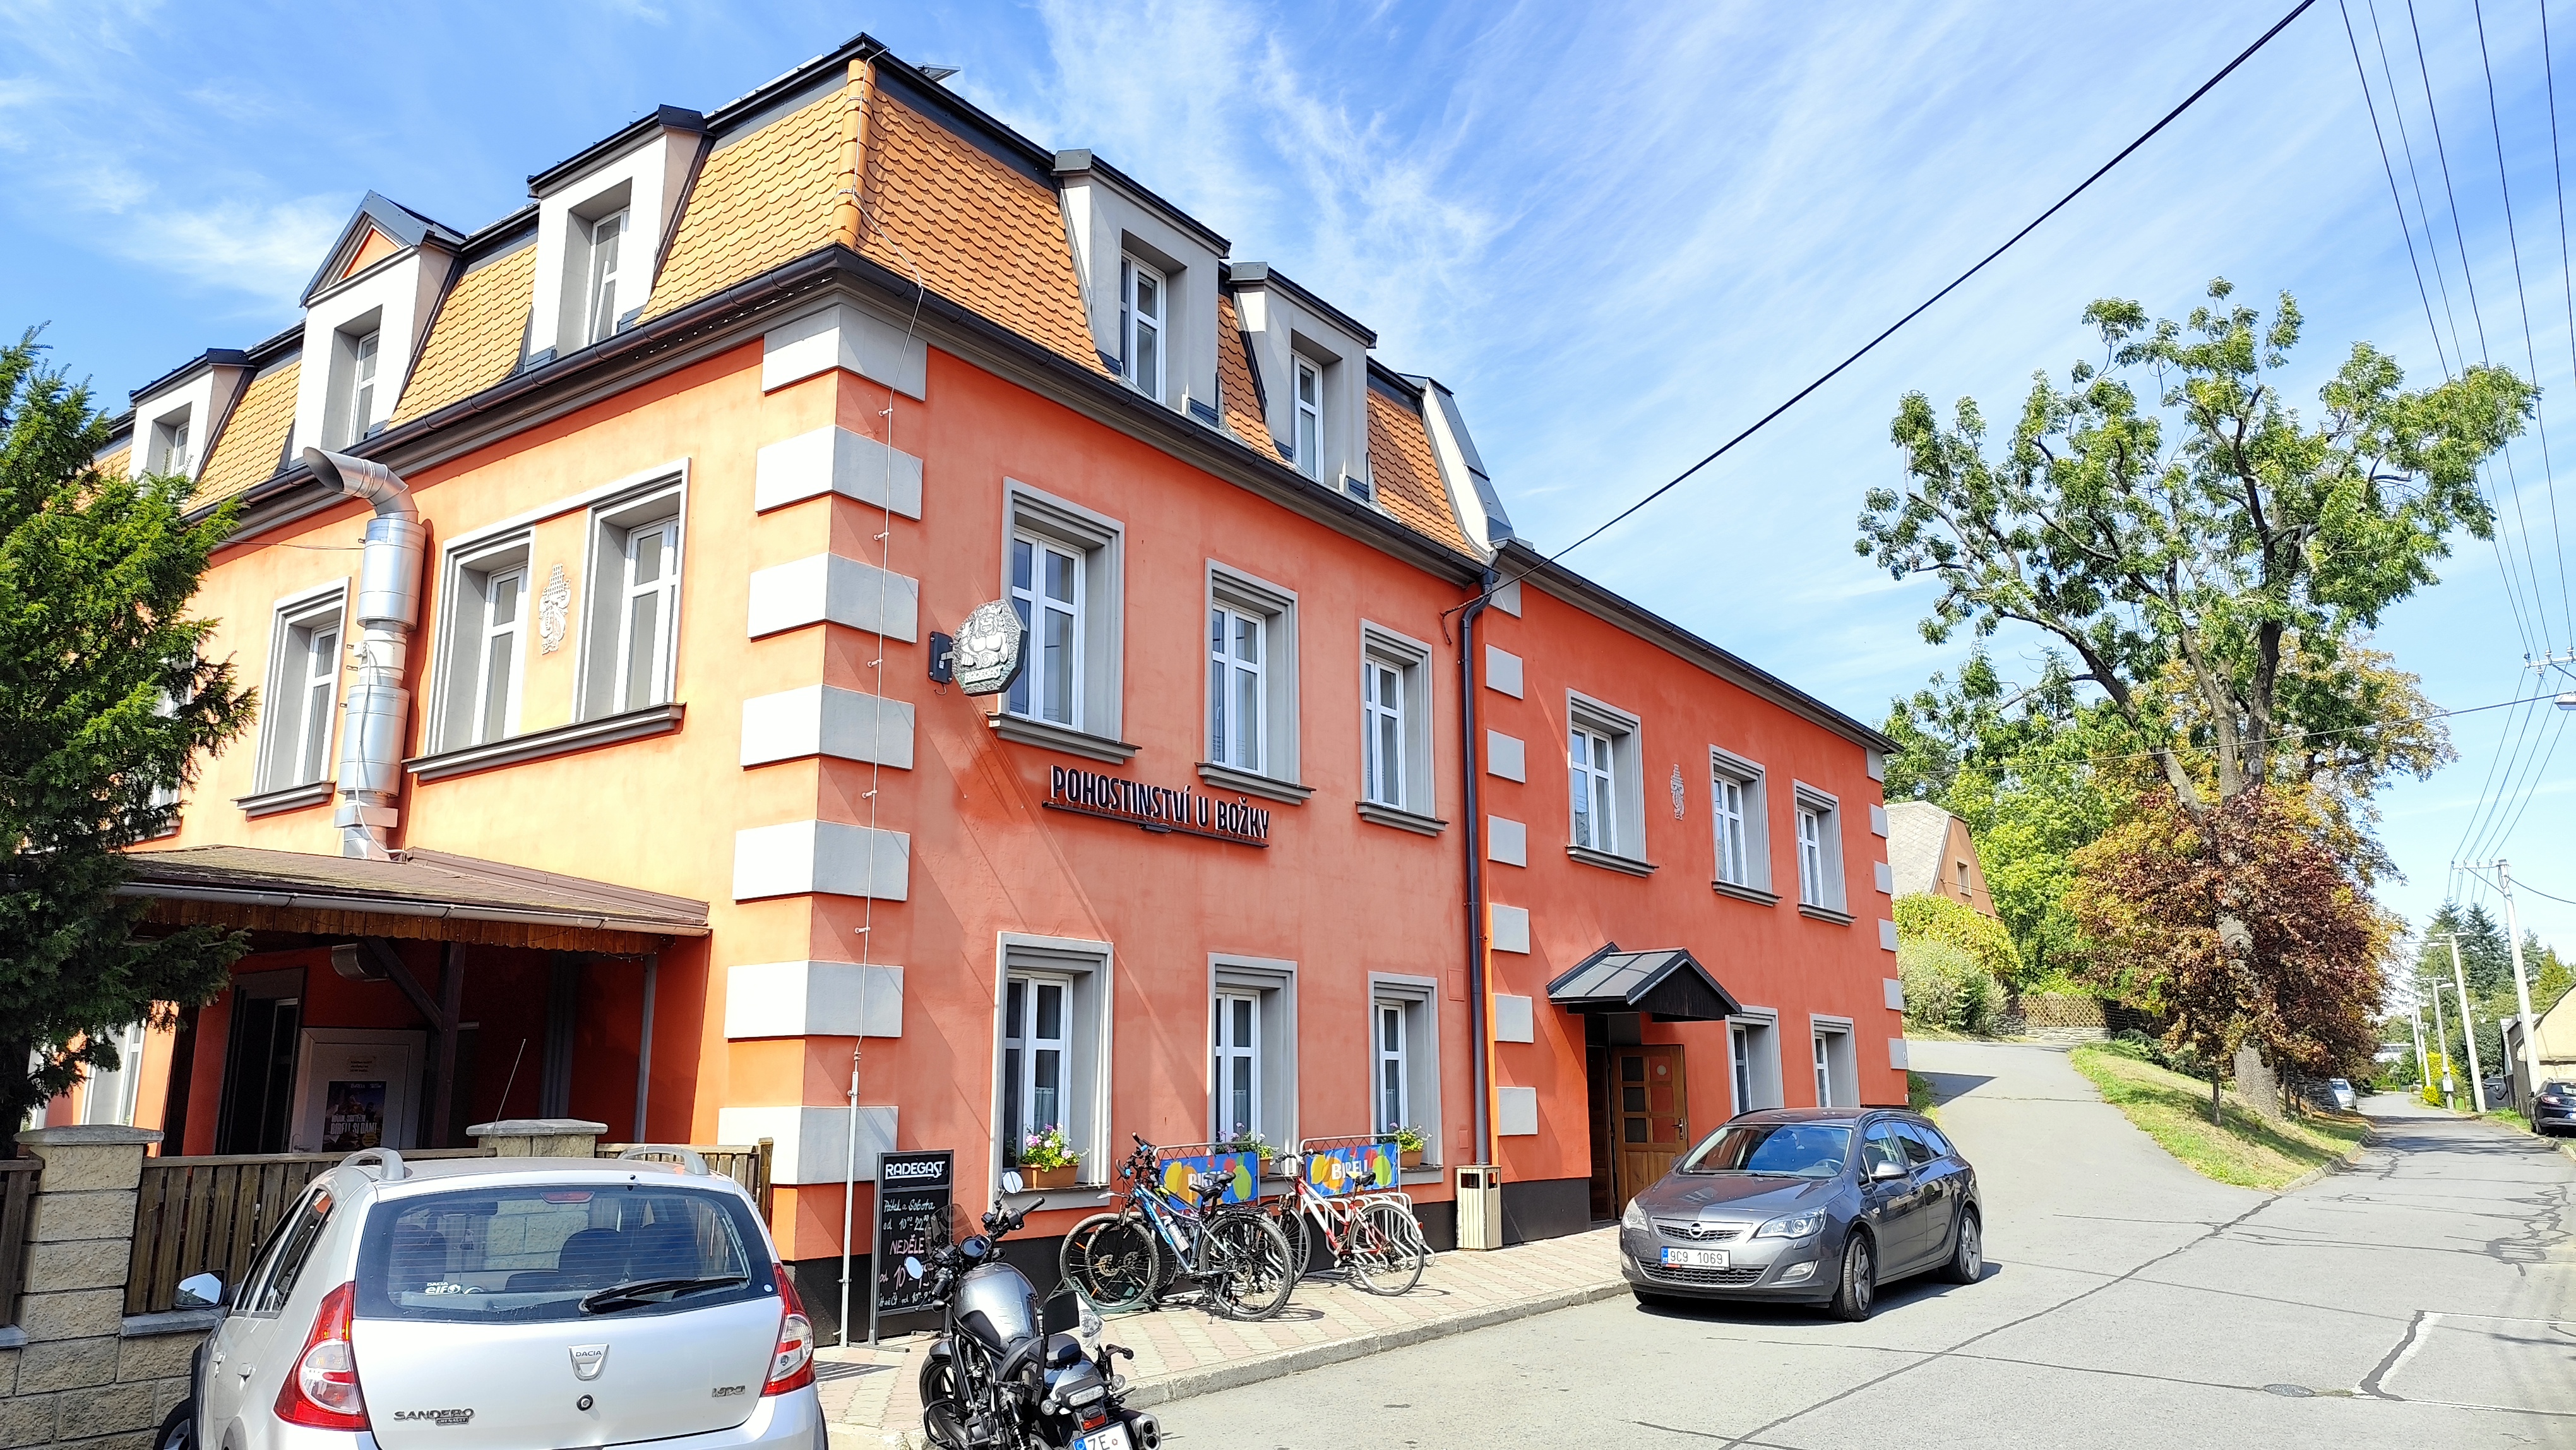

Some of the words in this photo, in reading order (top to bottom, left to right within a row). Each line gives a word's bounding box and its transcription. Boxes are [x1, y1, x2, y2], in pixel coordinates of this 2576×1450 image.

[1050, 764, 1191, 824] POHOSTINSTVÍ
[1196, 796, 1208, 827] U
[1215, 796, 1270, 839] BOŽKY
[885, 1161, 945, 1180] RADEGAST
[909, 1199, 936, 1211] Sobota
[883, 1218, 892, 1230] od
[890, 1234, 924, 1255] NEDĚLE
[1670, 1250, 1688, 1262] 9C9
[1697, 1252, 1722, 1264] 1069
[393, 1408, 475, 1422] SANDERO
